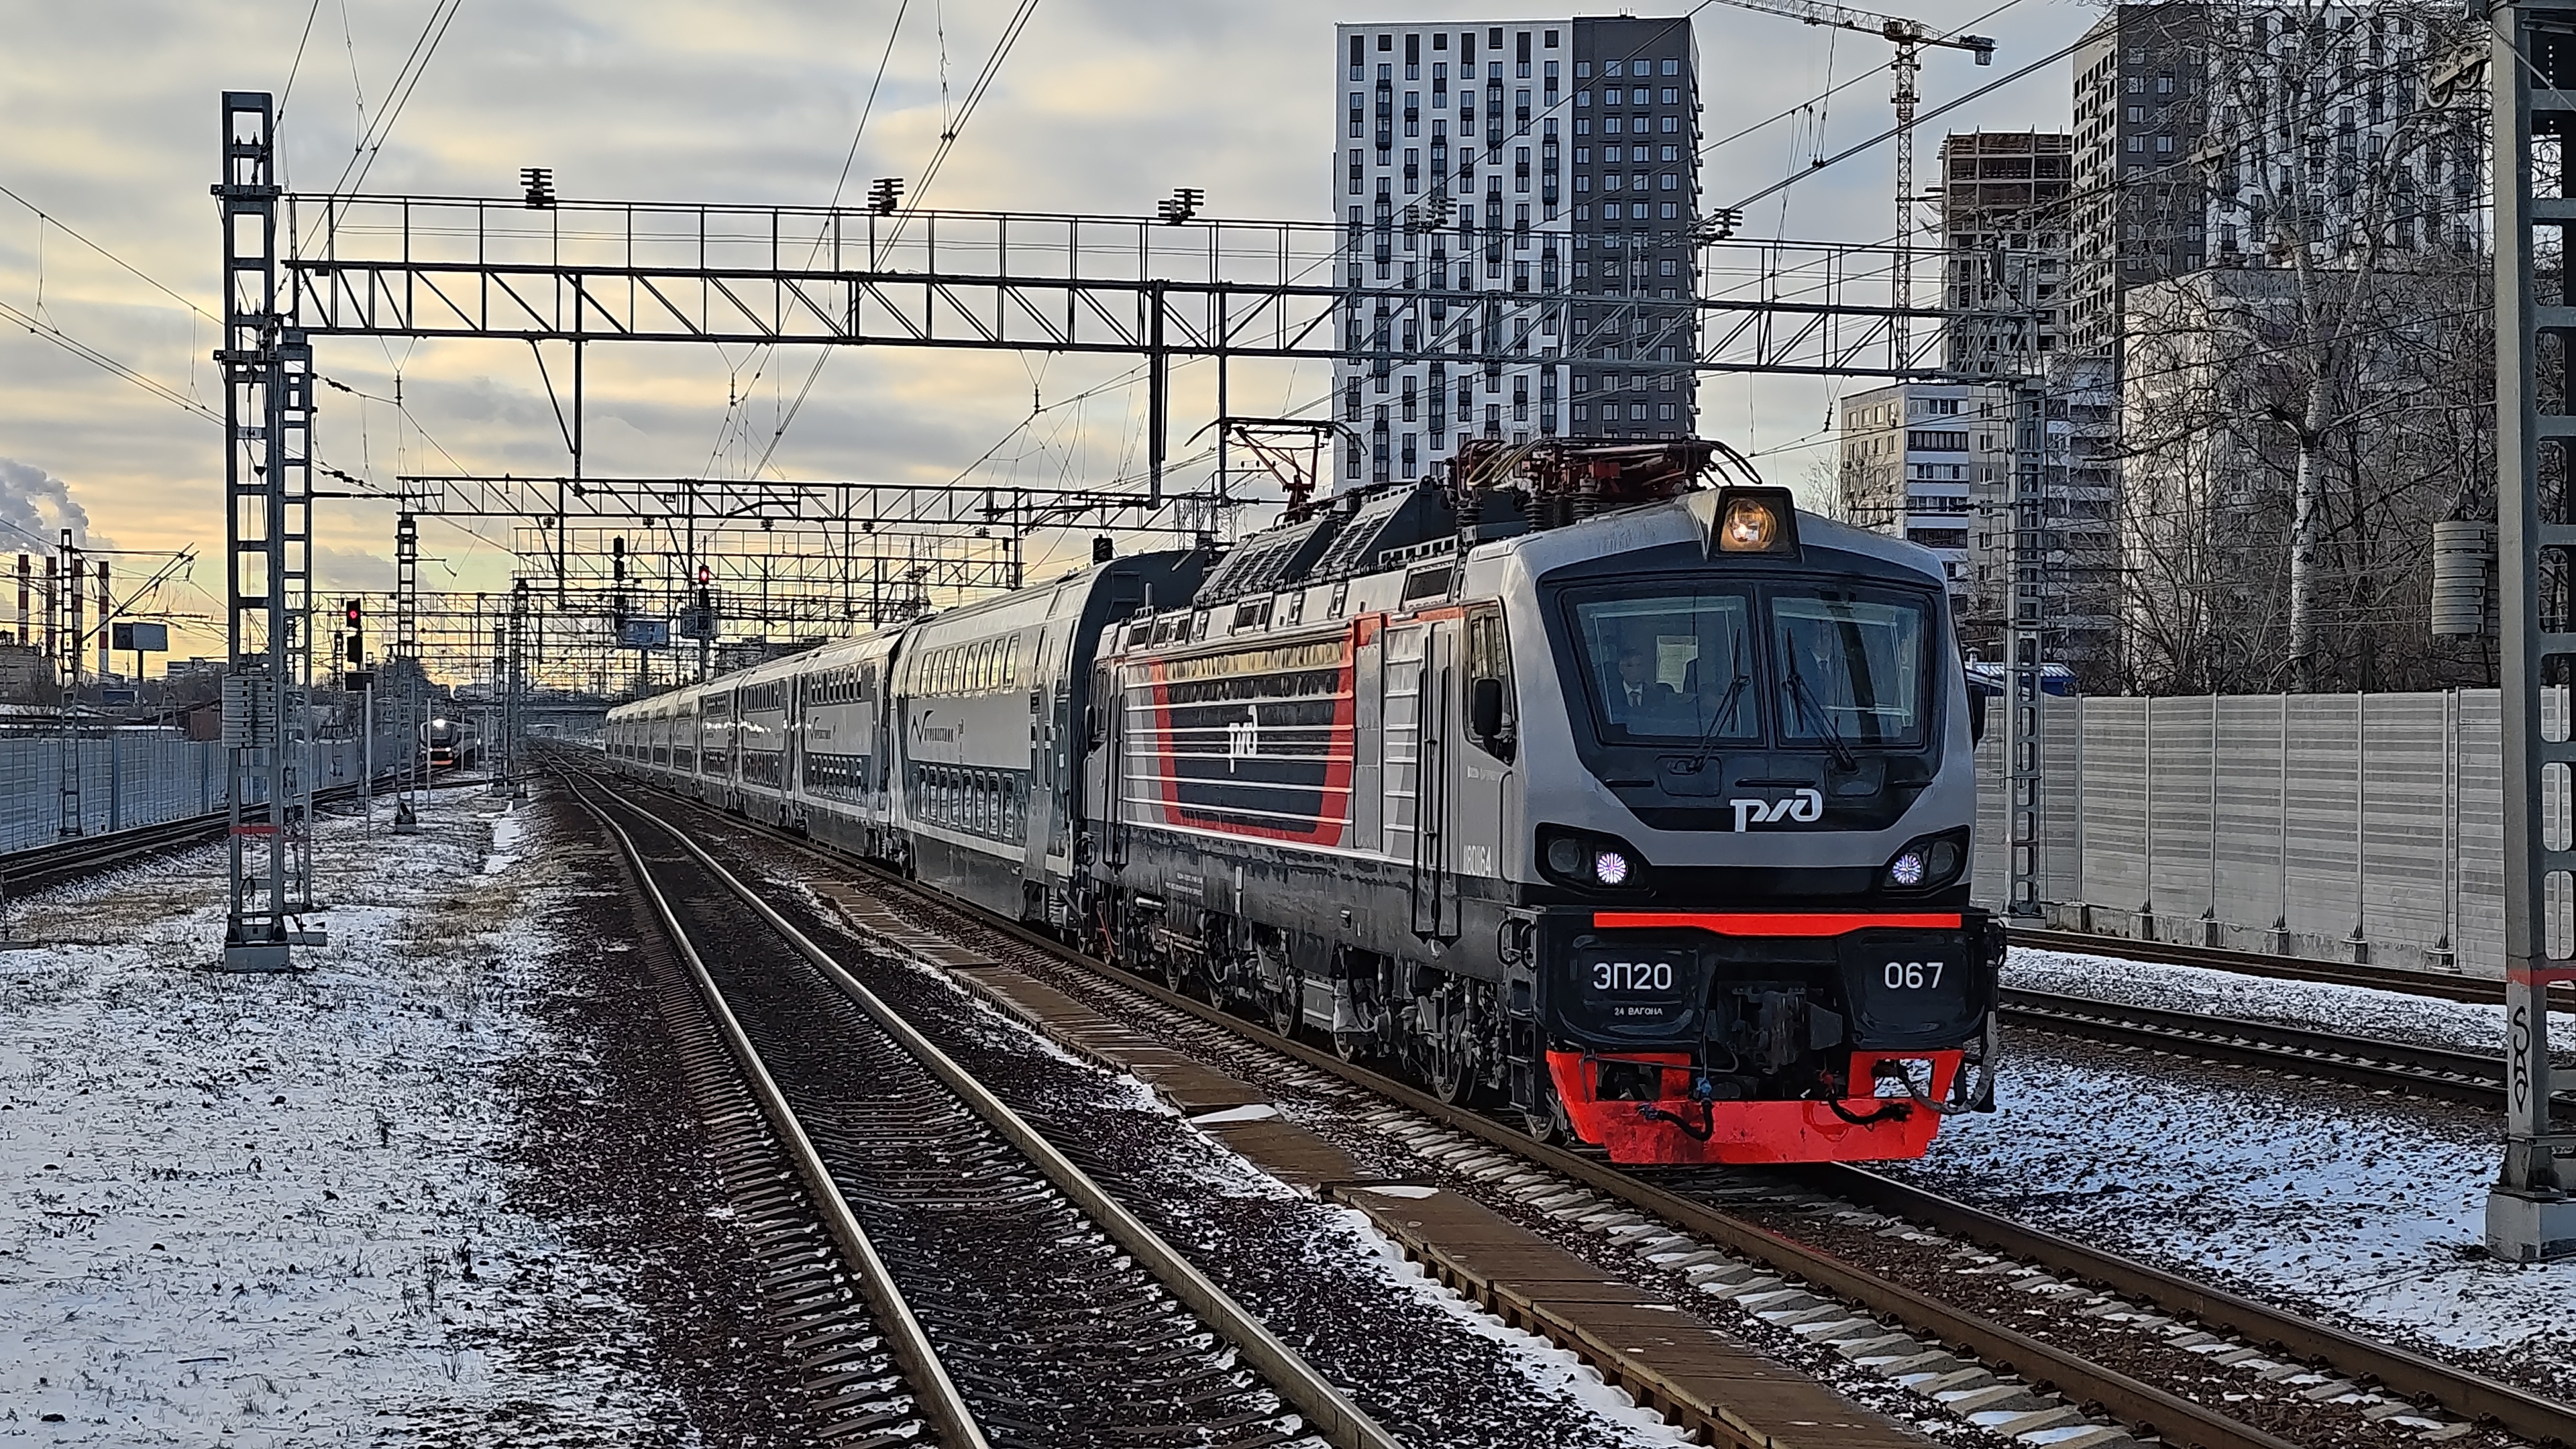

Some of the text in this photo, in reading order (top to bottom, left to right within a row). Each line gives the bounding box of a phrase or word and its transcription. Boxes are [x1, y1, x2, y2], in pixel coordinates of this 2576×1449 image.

[1593, 963, 1672, 989] ЭП20
[1884, 962, 1943, 989] 067
[1614, 1007, 1663, 1016] 24 ВАГОНА
